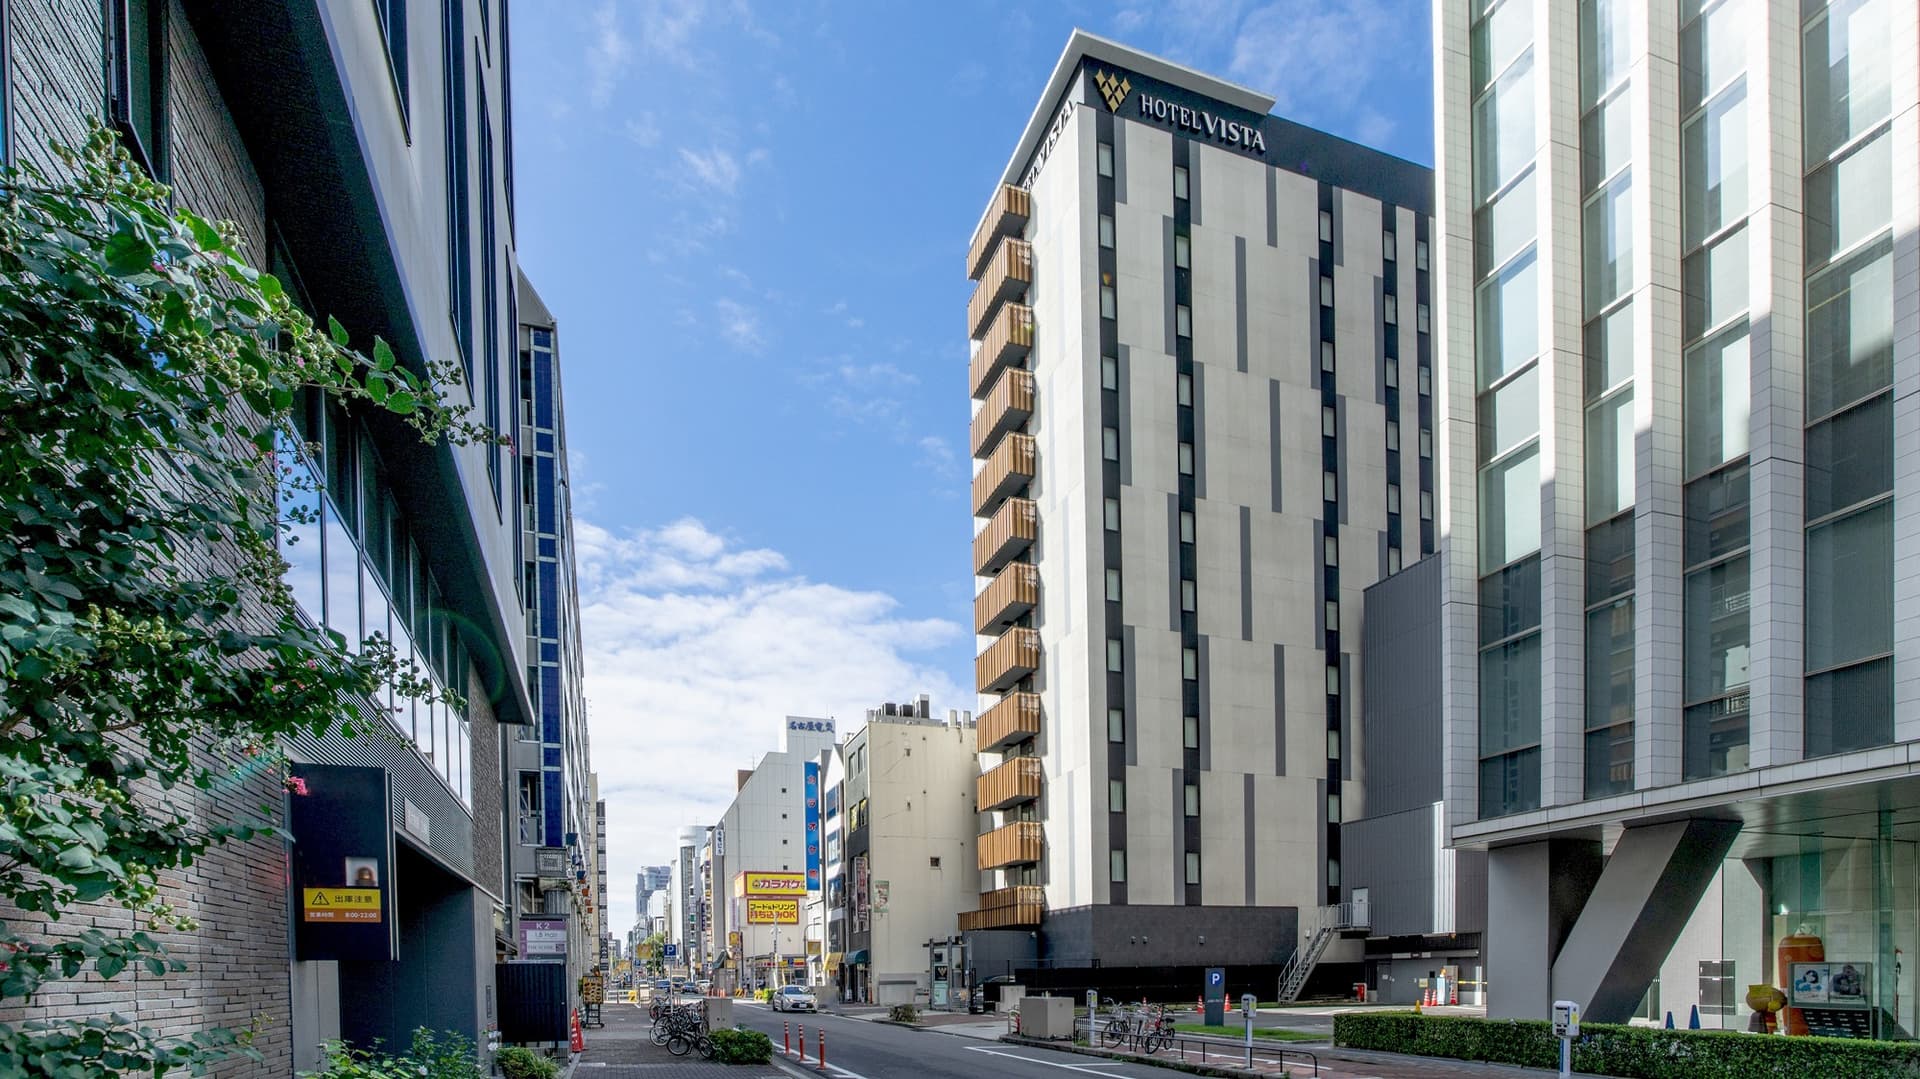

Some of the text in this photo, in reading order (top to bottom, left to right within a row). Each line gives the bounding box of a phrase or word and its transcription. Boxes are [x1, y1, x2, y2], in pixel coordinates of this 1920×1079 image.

[1140, 94, 1266, 152] HOTEL VISTA
[760, 879, 801, 889] カラオケ
[666, 945, 675, 955] P
[1211, 973, 1221, 985] P
